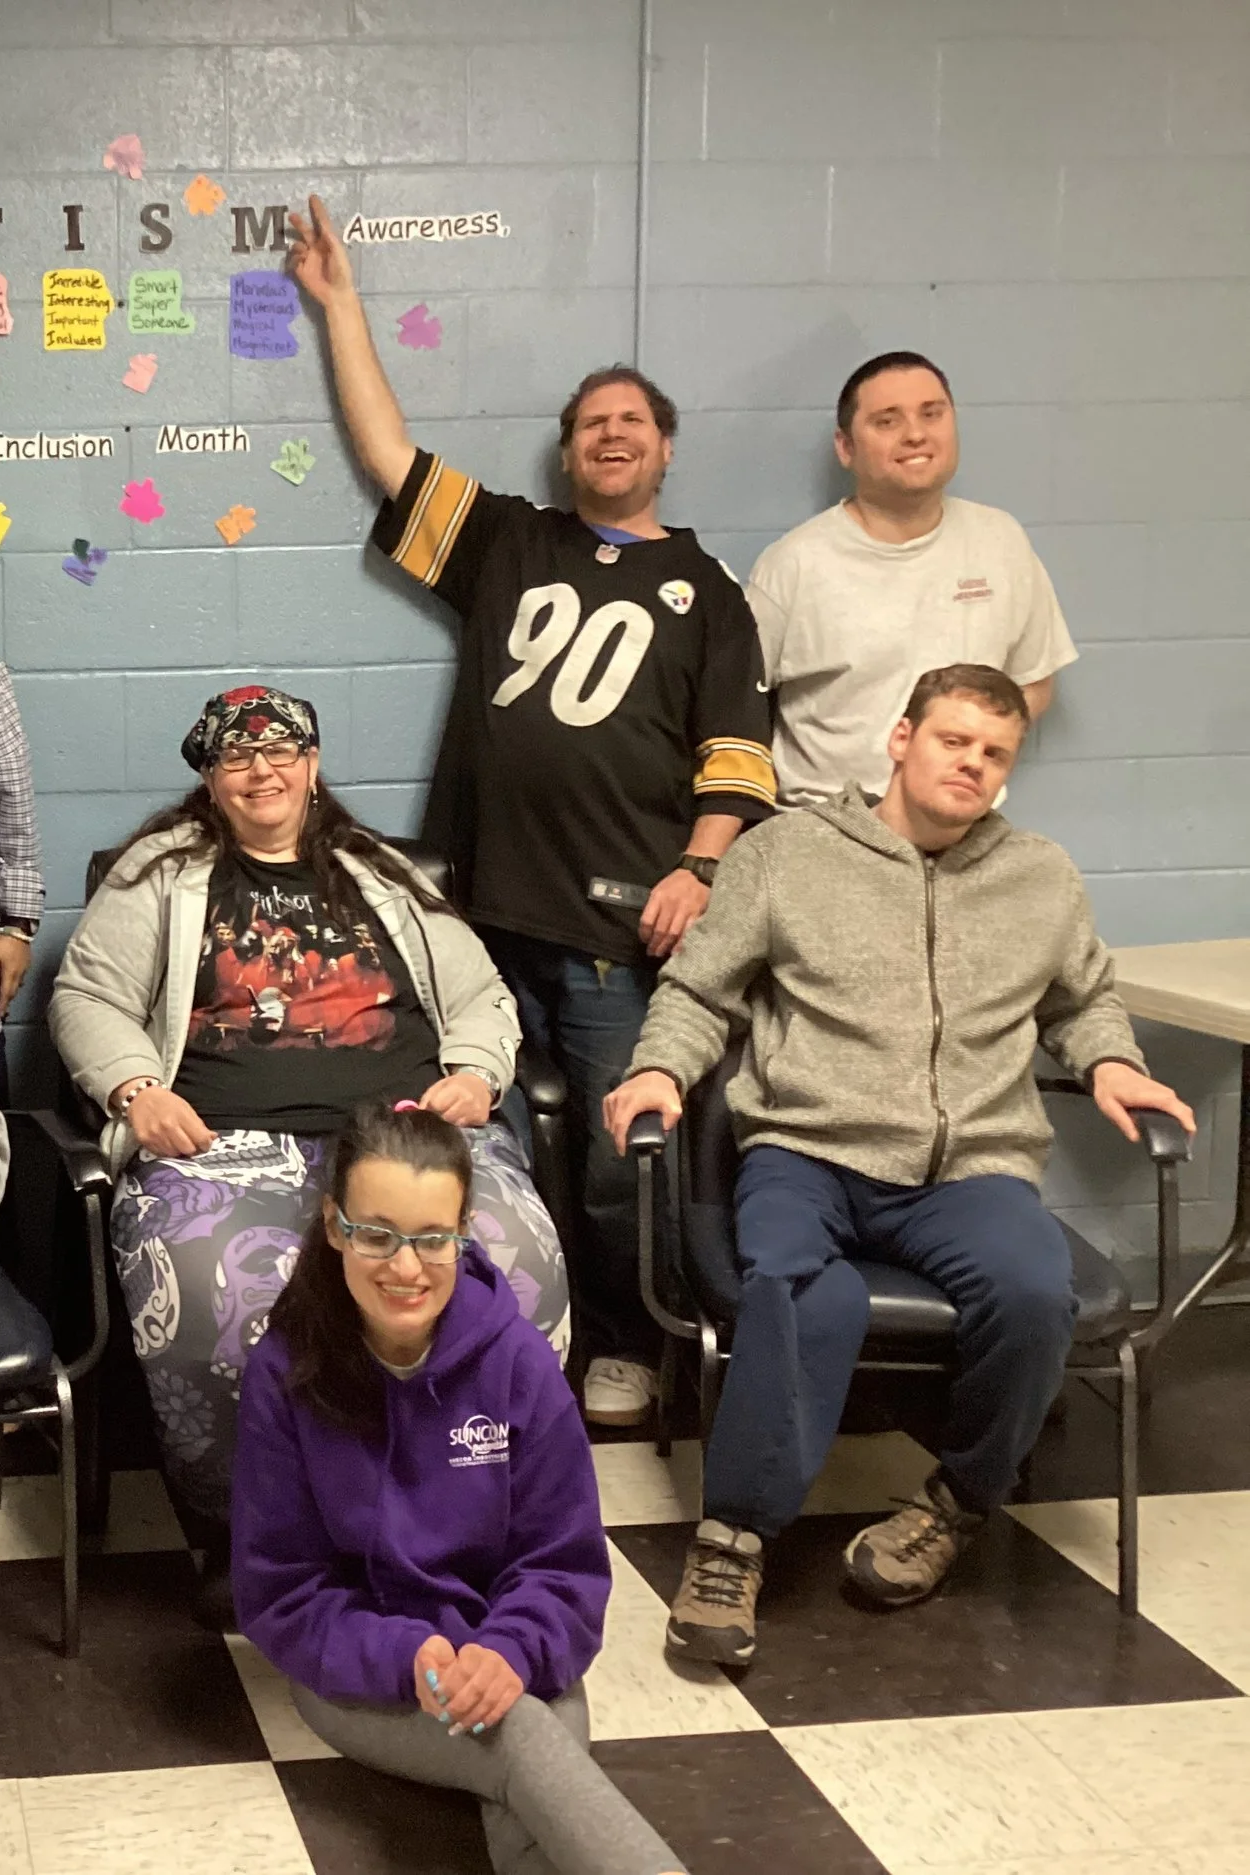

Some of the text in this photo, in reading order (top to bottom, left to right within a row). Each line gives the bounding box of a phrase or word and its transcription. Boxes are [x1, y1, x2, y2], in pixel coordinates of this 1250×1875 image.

[134, 276, 179, 295] Smart
[46, 293, 110, 313] Interesting
[133, 296, 176, 317] Super
[131, 314, 190, 330] Someone
[46, 330, 102, 346] Included
[157, 424, 248, 451] Month
[492, 582, 655, 727] 90
